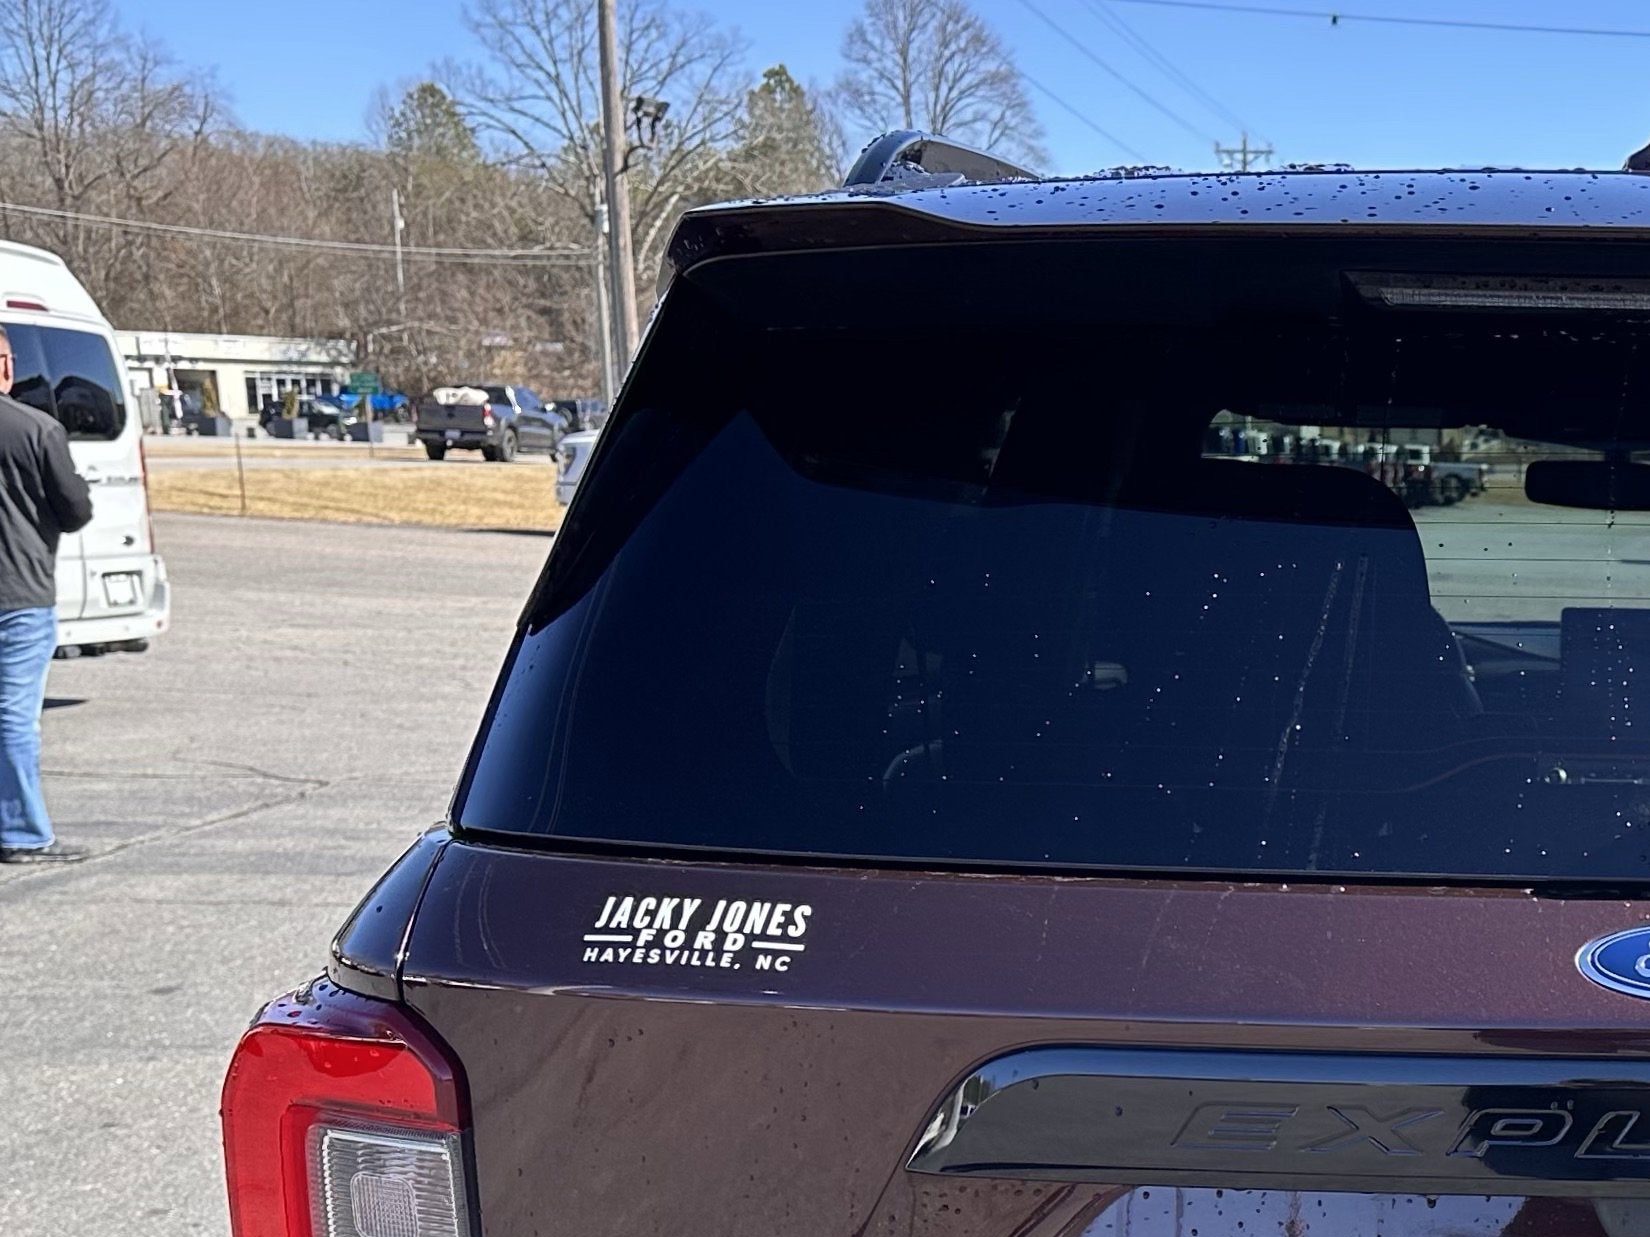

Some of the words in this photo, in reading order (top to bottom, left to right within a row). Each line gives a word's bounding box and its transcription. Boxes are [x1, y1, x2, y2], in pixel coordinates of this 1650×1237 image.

[594, 896, 701, 930] JACKY
[705, 900, 812, 938] JONES
[635, 929, 745, 951] FORD
[582, 947, 741, 970] HAYESVILLE,
[754, 954, 791, 972] NC
